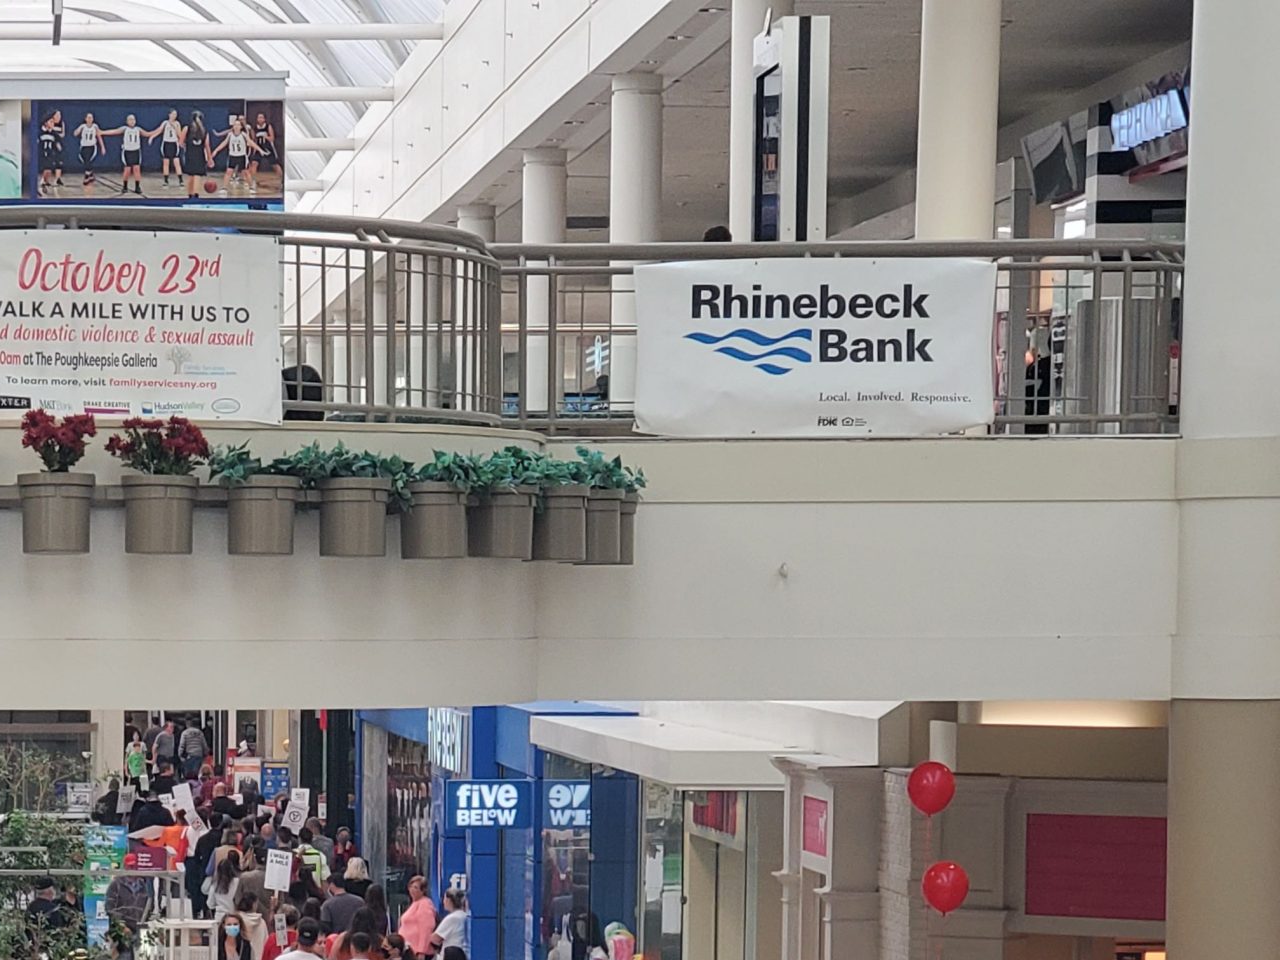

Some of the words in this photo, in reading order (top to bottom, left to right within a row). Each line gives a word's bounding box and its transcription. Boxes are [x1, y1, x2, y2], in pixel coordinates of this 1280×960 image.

[17, 248, 145, 296] October
[158, 253, 221, 294] 23rd
[691, 284, 930, 319] Rhinebeck
[49, 303, 65, 318] A
[71, 303, 122, 319] MILE
[129, 303, 183, 321] WITH
[191, 306, 217, 322] US
[222, 308, 250, 323] TO
[13, 323, 77, 341] domestic
[81, 324, 139, 342] violence
[144, 326, 157, 341] &
[159, 327, 205, 343] sexual
[208, 330, 254, 346] assault
[819, 328, 934, 362] Bank
[23, 353, 34, 366] at
[35, 352, 54, 366] The
[54, 353, 120, 371] Poughkeepsie
[121, 353, 158, 368] Galleria
[6, 376, 19, 384] To
[21, 376, 48, 385] learn
[51, 377, 81, 387] more,
[83, 377, 107, 386] visit
[109, 378, 218, 390] familyservicesny.org
[819, 392, 850, 402] Local.
[857, 392, 905, 402] Involved.
[911, 392, 972, 404] Responsive.
[817, 416, 838, 427] FDIC
[456, 783, 519, 809] five
[456, 809, 518, 827] BELOW
